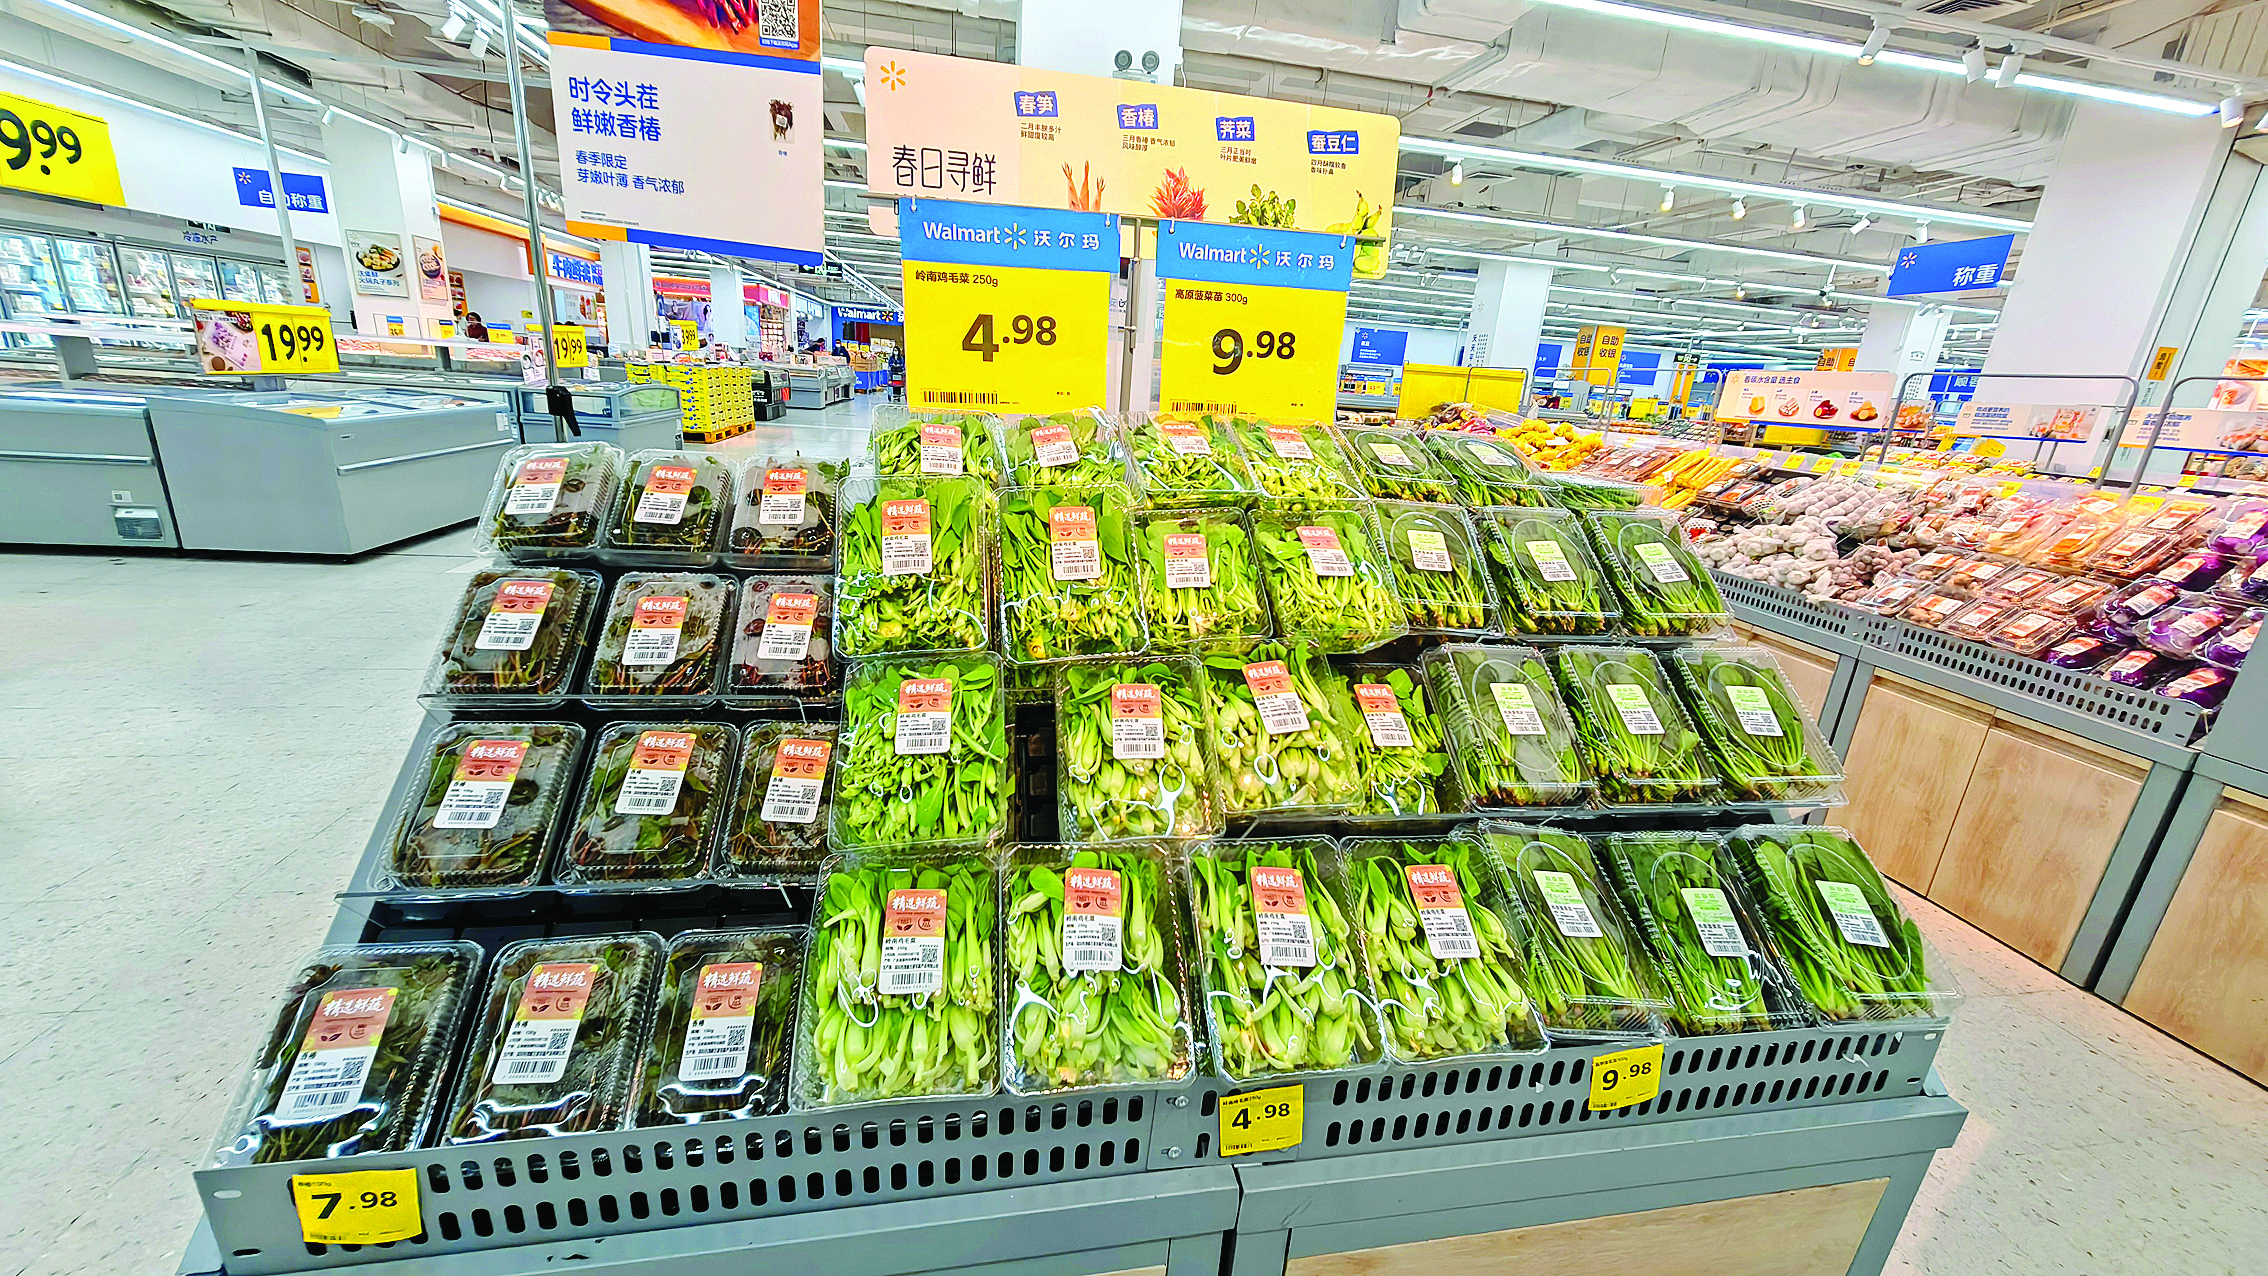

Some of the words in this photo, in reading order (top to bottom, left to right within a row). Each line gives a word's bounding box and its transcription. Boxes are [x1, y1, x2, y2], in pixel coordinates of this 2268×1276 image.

[568, 76, 659, 110] 时令头茬
[1018, 94, 1054, 115] 春笋
[571, 107, 662, 142] 鲜嫩香椿
[1121, 107, 1155, 127] 香椿
[1020, 131, 1055, 141] 鲜甜度较高
[1219, 120, 1251, 139] 荠菜
[1122, 134, 1148, 144] 三月香椿
[1150, 137, 1176, 147] 香气浓郁
[1311, 134, 1357, 152] 蚕豆仁
[575, 149, 628, 170] 春季限定
[1220, 146, 1251, 156] 三月正当时
[1220, 154, 1257, 164] 叶片肥美鲜嫩
[892, 144, 997, 196] 春日寻鲜
[577, 168, 629, 188] 芽嫩叶薄
[632, 174, 685, 195] 香气浓郁
[922, 221, 1001, 244] Walmart
[1033, 230, 1100, 250] 沃尔玛
[1178, 242, 1247, 264] Walmart
[1275, 251, 1334, 270] 沃尔玛
[915, 270, 970, 284] 岭南鸡毛菜
[972, 273, 999, 288] 250g
[1952, 262, 1999, 286] 称重
[1174, 288, 1223, 302] 高原菠菜苗
[1225, 292, 1248, 306] 300g
[838, 307, 881, 320] Walmart
[261, 323, 325, 362] 19.99
[961, 313, 1057, 362] 4.98
[1602, 335, 1619, 345] 自助
[554, 337, 582, 362] 19.99
[1211, 328, 1296, 375] 9.98
[1599, 348, 1616, 358] 收银
[1818, 357, 1835, 366] 自助
[1744, 375, 1778, 384] 看碳水含量
[1778, 376, 1801, 384] 选主食
[1070, 873, 1116, 890] 精选鲜蔬
[1256, 872, 1298, 888] 精选鲜蔬
[892, 894, 941, 911] 精选鲜蔬
[532, 971, 587, 989] 精选鲜蔬
[703, 970, 755, 989] 精选鲜蔬
[322, 995, 385, 1017] 精选鲜蔬
[1602, 1062, 1652, 1091] 9.98
[1231, 1102, 1290, 1130] 4.98
[311, 1191, 398, 1220] 7.98
